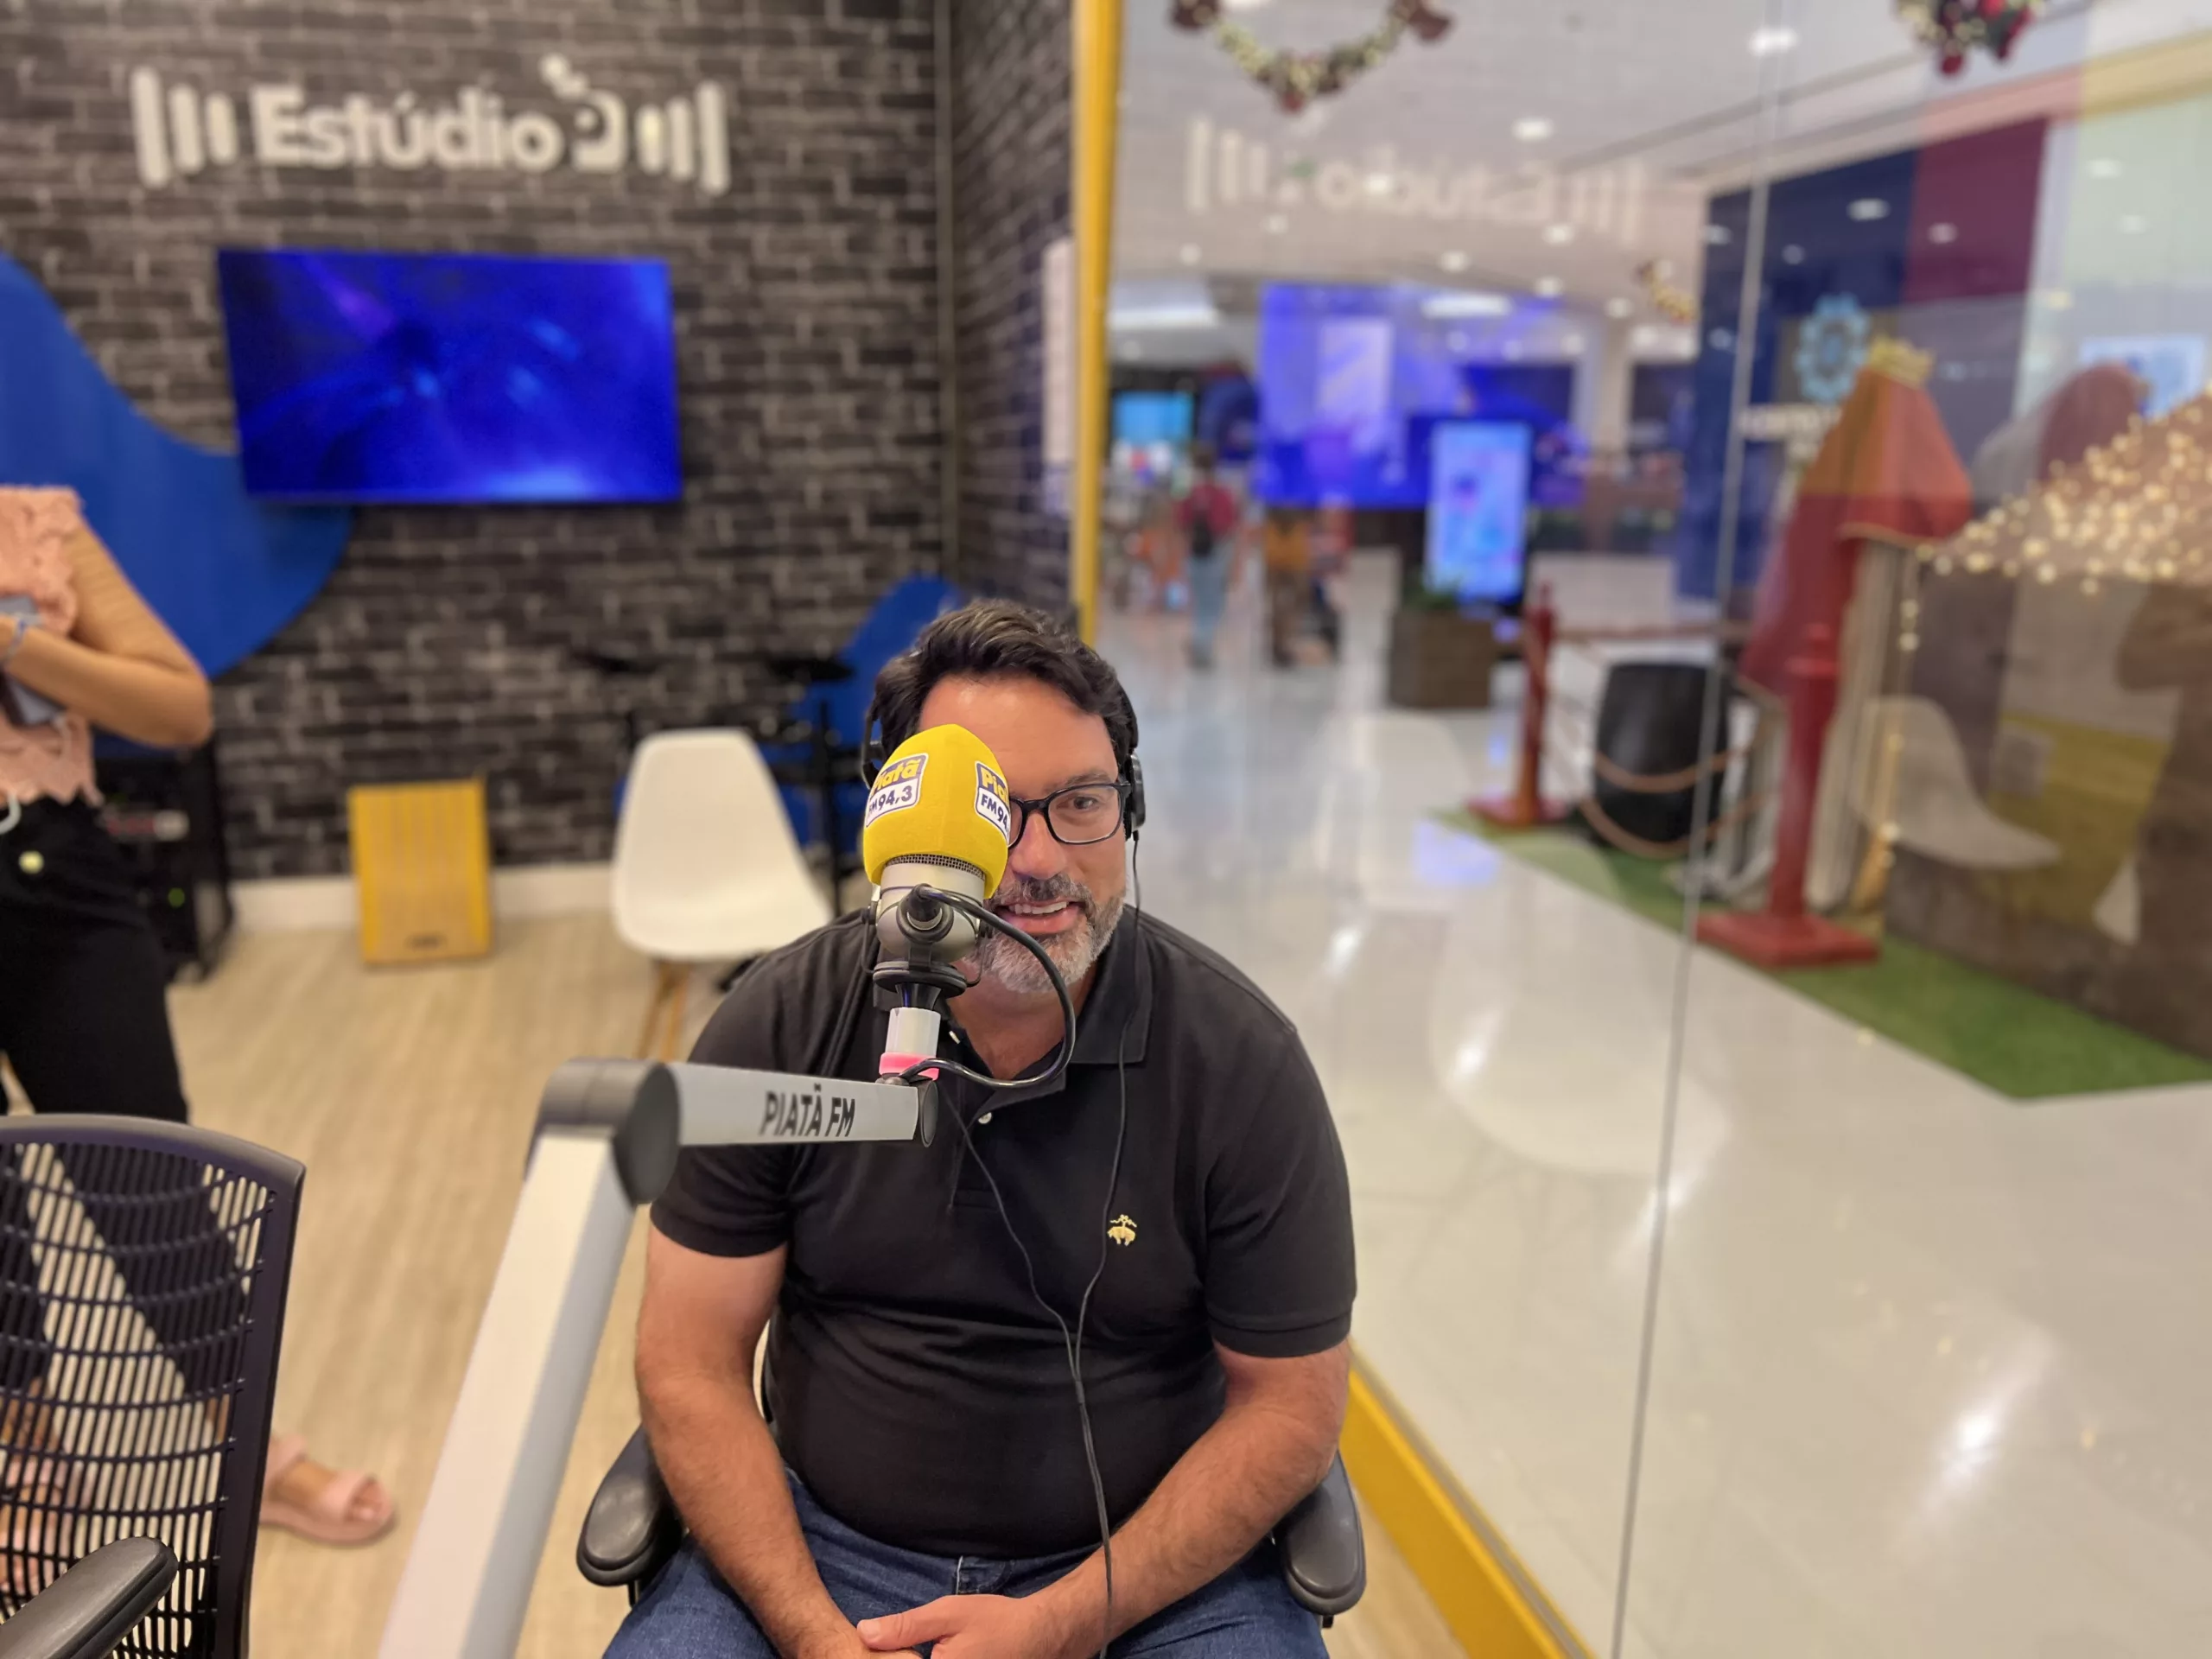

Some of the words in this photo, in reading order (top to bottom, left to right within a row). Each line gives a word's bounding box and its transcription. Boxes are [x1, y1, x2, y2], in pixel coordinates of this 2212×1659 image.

[250, 84, 564, 171] Estúdio
[980, 766, 1009, 806] Pia
[758, 1082, 822, 1137] PIATÃ
[823, 1096, 855, 1137] FM
